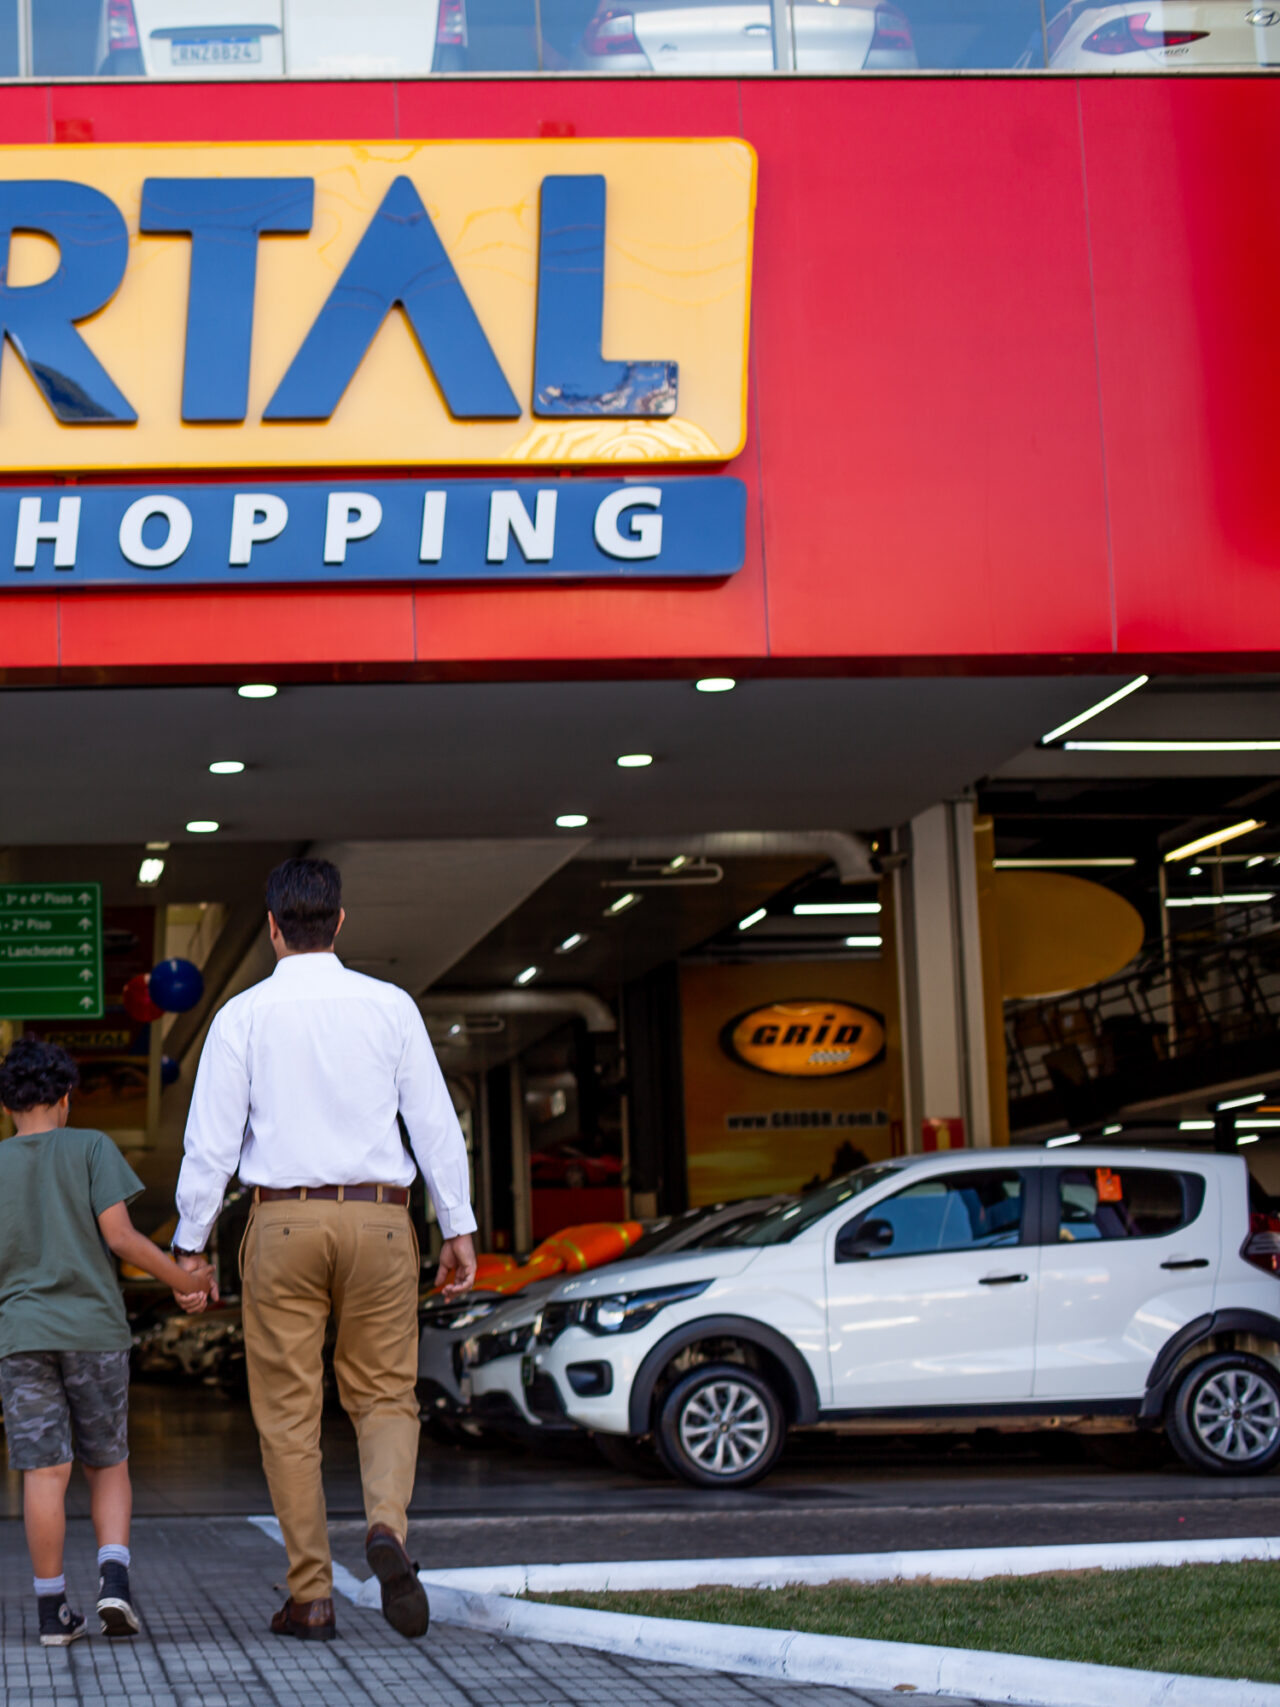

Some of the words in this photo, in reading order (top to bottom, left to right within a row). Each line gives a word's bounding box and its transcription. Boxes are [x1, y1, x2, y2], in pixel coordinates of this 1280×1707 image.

[44, 891, 73, 904] Pisos
[27, 918, 52, 930] Piso
[8, 945, 75, 957] Lanchonete
